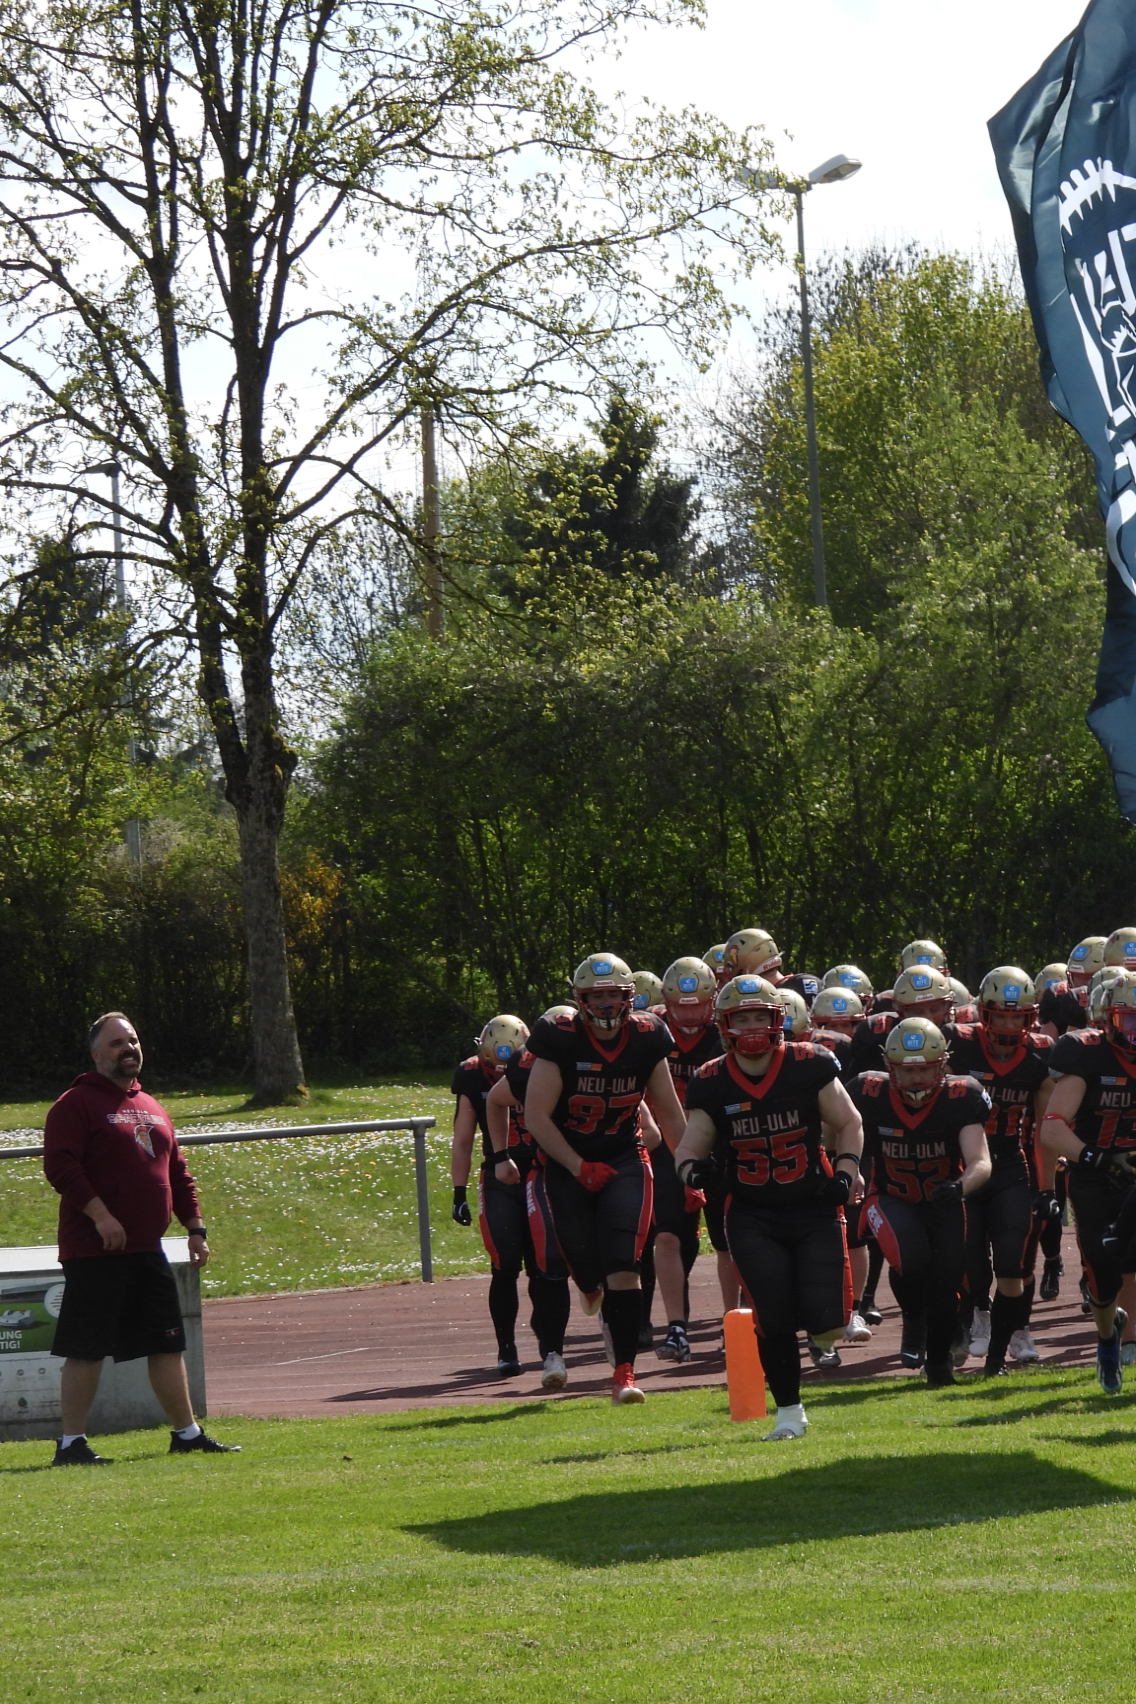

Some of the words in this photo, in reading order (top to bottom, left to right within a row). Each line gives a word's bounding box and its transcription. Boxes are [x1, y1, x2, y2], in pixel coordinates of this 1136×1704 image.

[578, 1077, 637, 1094] NEU-ULM
[565, 1093, 646, 1136] 97
[732, 1109, 800, 1137] NEU-ULM
[731, 1126, 808, 1186] 55
[883, 1141, 947, 1159] NEU-ULM
